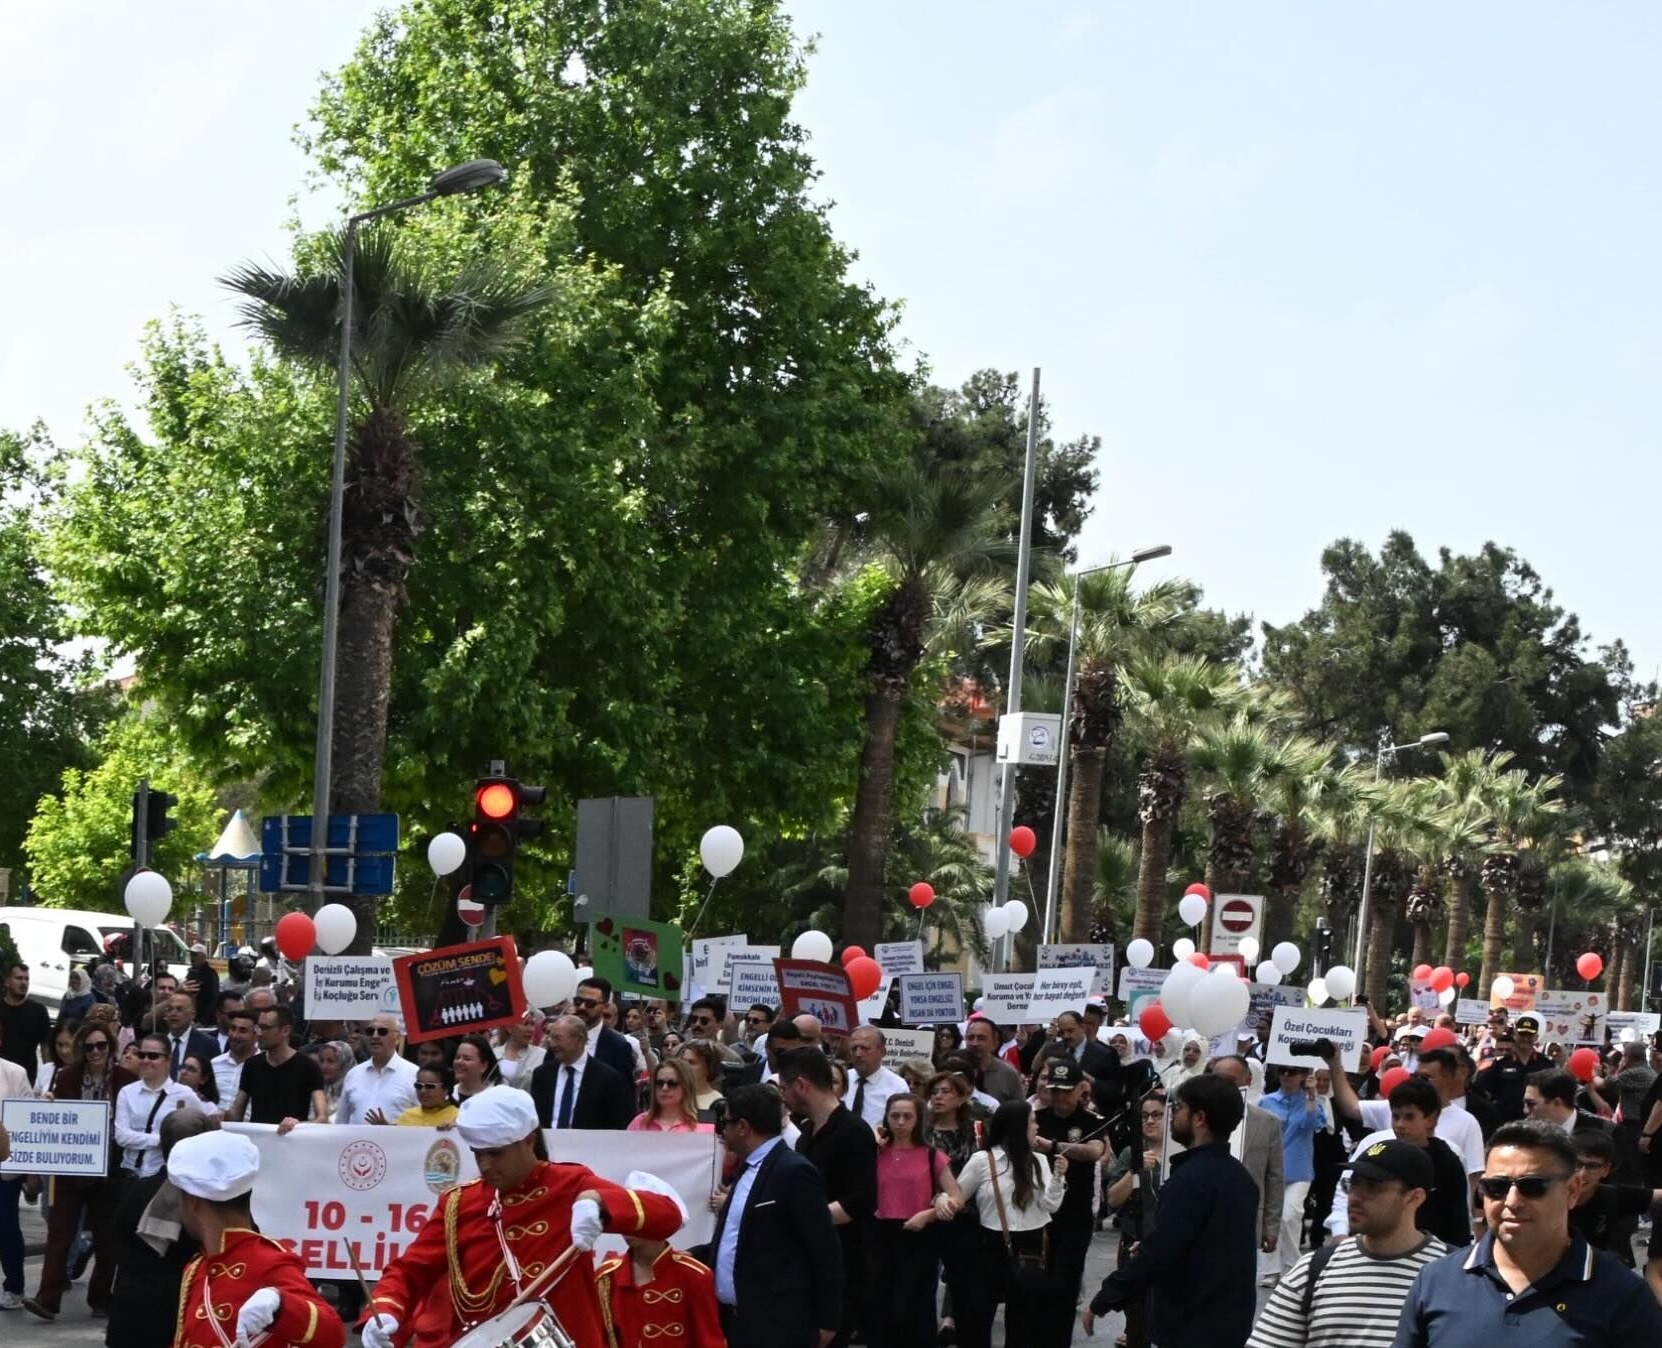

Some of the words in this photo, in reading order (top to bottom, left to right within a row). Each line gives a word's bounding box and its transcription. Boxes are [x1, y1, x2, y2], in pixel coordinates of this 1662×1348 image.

[313, 964, 343, 975] Denizli
[344, 964, 379, 976] Çalışma
[380, 966, 391, 975] ve
[740, 972, 768, 981] ENGELLİ
[324, 978, 358, 987] Kurumu
[738, 982, 771, 993] KİMSENİN
[994, 982, 1013, 990] Umut
[1040, 981, 1052, 990] Her
[323, 990, 358, 1003] Koçluğu
[987, 993, 1015, 1001] Koruma
[1044, 991, 1063, 1002] hayat
[1284, 1019, 1305, 1032] Özel
[1306, 1023, 1353, 1037] Çocukları
[30, 1112, 59, 1124] BENDE
[62, 1110, 78, 1125] BİR
[61, 1130, 100, 1146] KENDİMİ
[9, 1148, 34, 1163] SİZDE
[36, 1151, 96, 1165] BULUYORUM.
[305, 1200, 346, 1231] 10
[388, 1203, 430, 1233] 16
